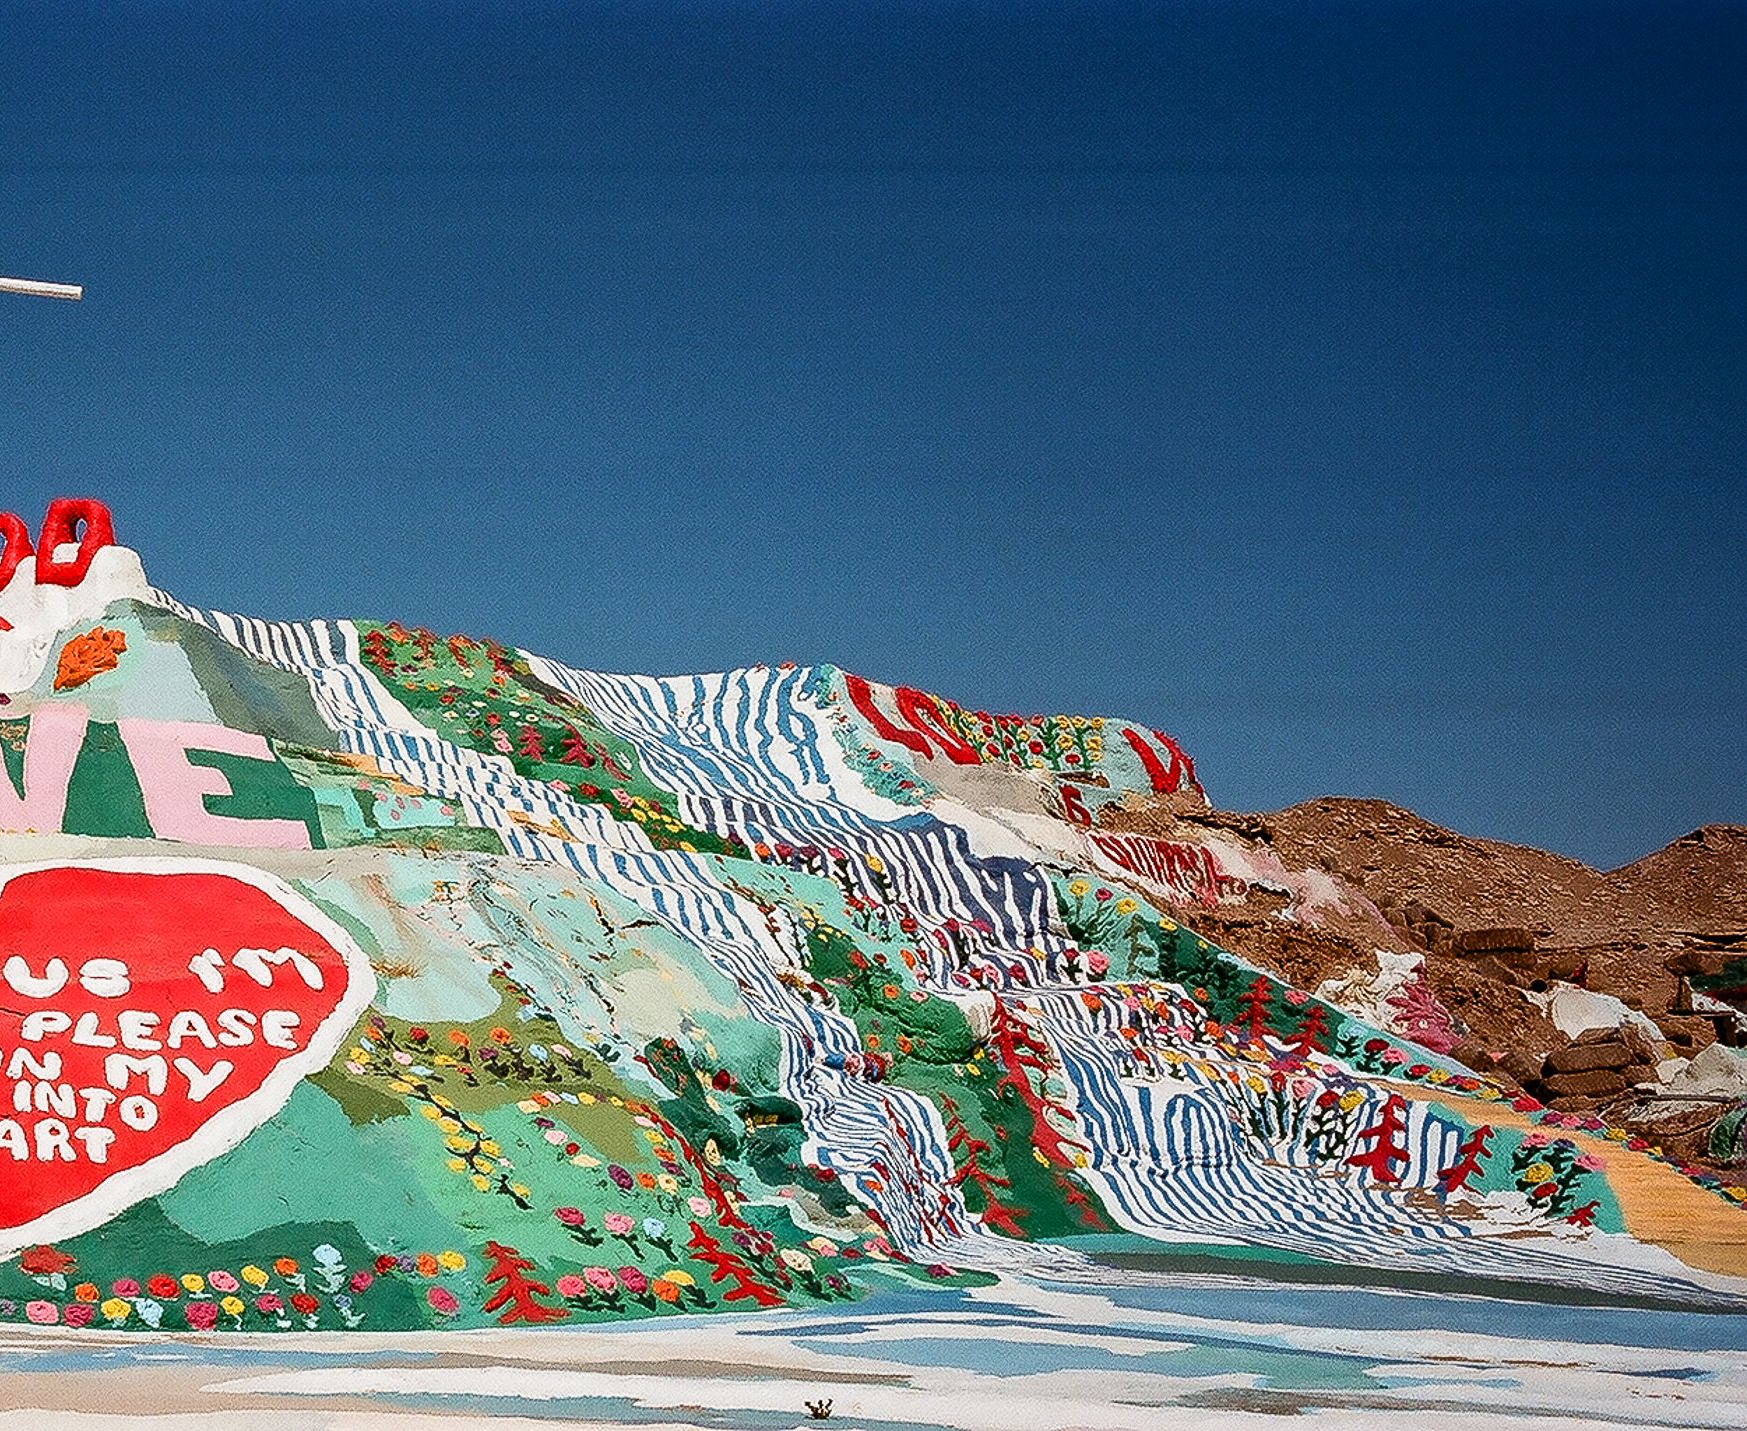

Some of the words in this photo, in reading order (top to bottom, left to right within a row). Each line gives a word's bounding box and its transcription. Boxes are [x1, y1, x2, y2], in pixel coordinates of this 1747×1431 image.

[19, 1007, 302, 1052] PLEASE
[105, 1052, 235, 1103] MY
[12, 1078, 160, 1132] INTO
